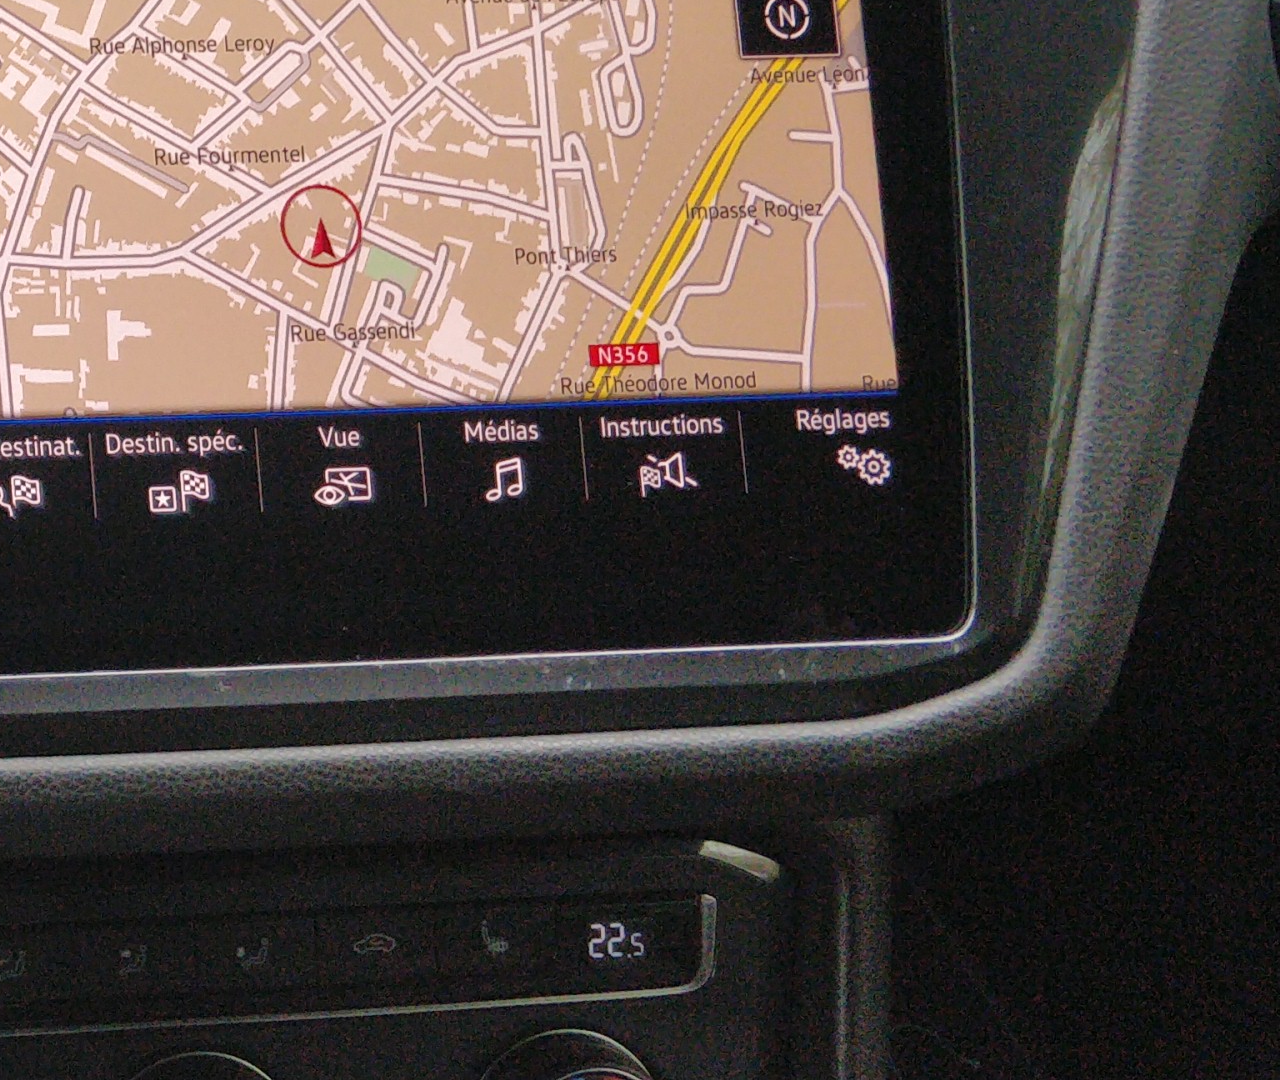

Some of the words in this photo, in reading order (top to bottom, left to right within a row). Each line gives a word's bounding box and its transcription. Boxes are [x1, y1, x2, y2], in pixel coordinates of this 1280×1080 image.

[778, 4, 796, 28] N
[89, 37, 126, 54] Rue
[131, 35, 218, 58] Alphonse
[225, 35, 275, 56] Leroy
[750, 68, 816, 84] Avenue
[154, 148, 191, 166] Rue
[198, 145, 305, 165] Fourmentel
[685, 202, 757, 220] Impasse
[765, 201, 823, 220] Rogiez
[514, 248, 557, 265] Pont
[563, 246, 618, 263] Thiers
[291, 325, 326, 343] Rue
[333, 322, 416, 342] Gassendi
[597, 347, 649, 364] N356
[560, 377, 596, 395] Rue
[602, 373, 688, 393] Théodore
[694, 371, 757, 389] Monod
[464, 420, 539, 443] Médias
[600, 416, 723, 438] Instructions
[797, 407, 890, 436] Réglages
[105, 433, 180, 455] Destin.
[187, 430, 244, 455] spéc.
[318, 426, 361, 448] Vue
[588, 922, 645, 959] 22.5
